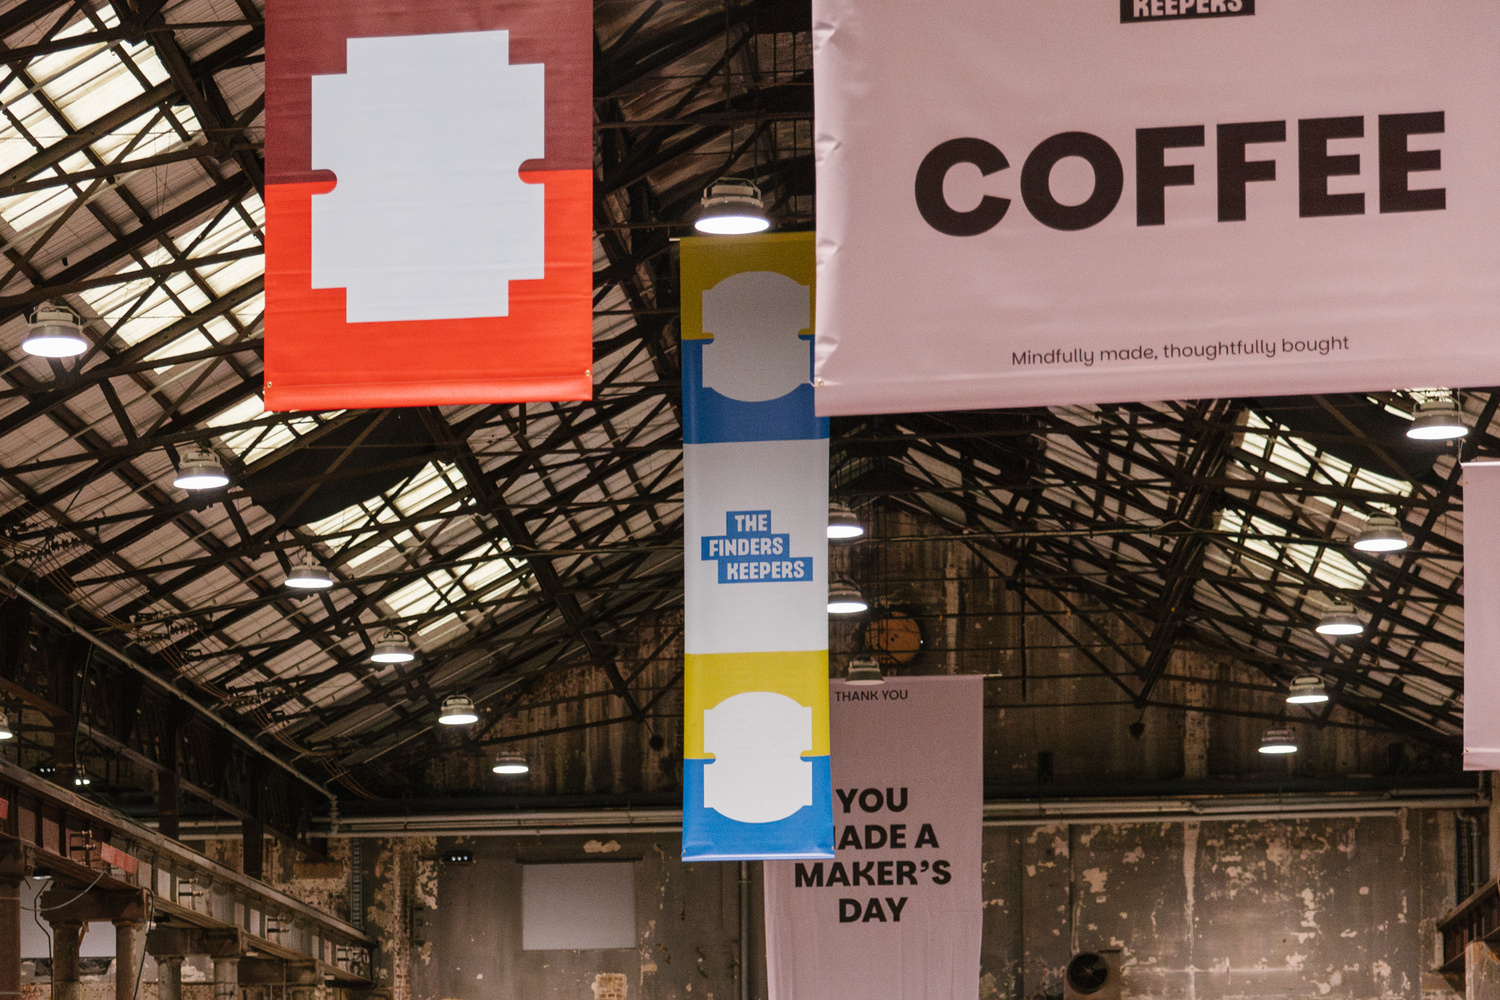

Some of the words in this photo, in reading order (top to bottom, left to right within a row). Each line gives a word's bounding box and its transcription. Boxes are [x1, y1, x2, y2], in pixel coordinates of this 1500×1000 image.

[915, 111, 1447, 237] COFFEE
[1011, 347, 1095, 366] Mindfully
[1100, 345, 1158, 362] made,
[1162, 340, 1277, 361] thoughtfully
[1281, 335, 1349, 356] bought
[734, 514, 768, 533] THE
[709, 537, 784, 557] FINDERS
[726, 560, 805, 581] KEEPERS
[834, 690, 879, 702] THANK
[881, 689, 909, 701] YOU
[835, 787, 908, 814] YOU
[834, 824, 907, 850] ADE
[914, 823, 940, 849] A
[838, 896, 909, 924] DAY
